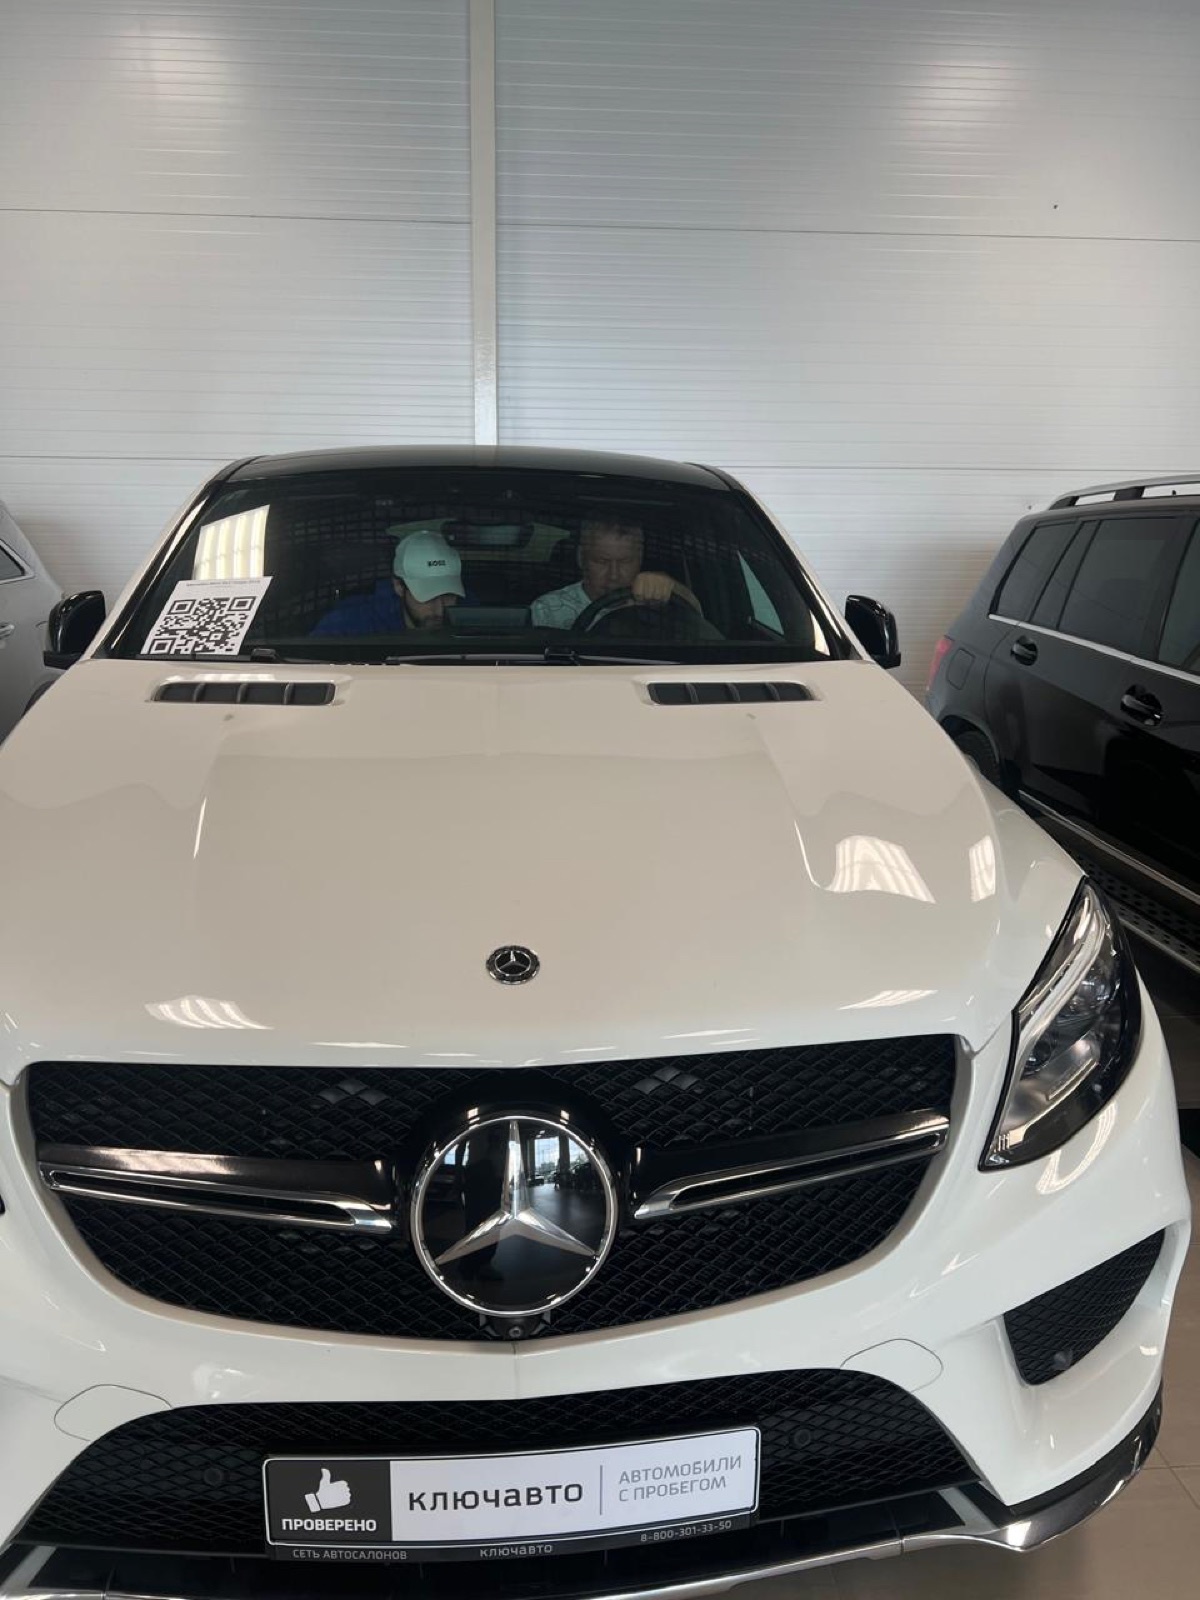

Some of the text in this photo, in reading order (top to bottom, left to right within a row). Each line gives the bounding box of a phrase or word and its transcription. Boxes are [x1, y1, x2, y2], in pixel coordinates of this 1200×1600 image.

[619, 1455, 742, 1485] АВТОМОБИЛИ
[619, 1475, 727, 1502] С ПРОБЕГОМ
[281, 1518, 377, 1532] ПРОВЕРЕНО
[640, 1520, 732, 1542] 8-800-301-33-50
[292, 1550, 408, 1561] СЕТЬ АВТОСАЛОНОВ
